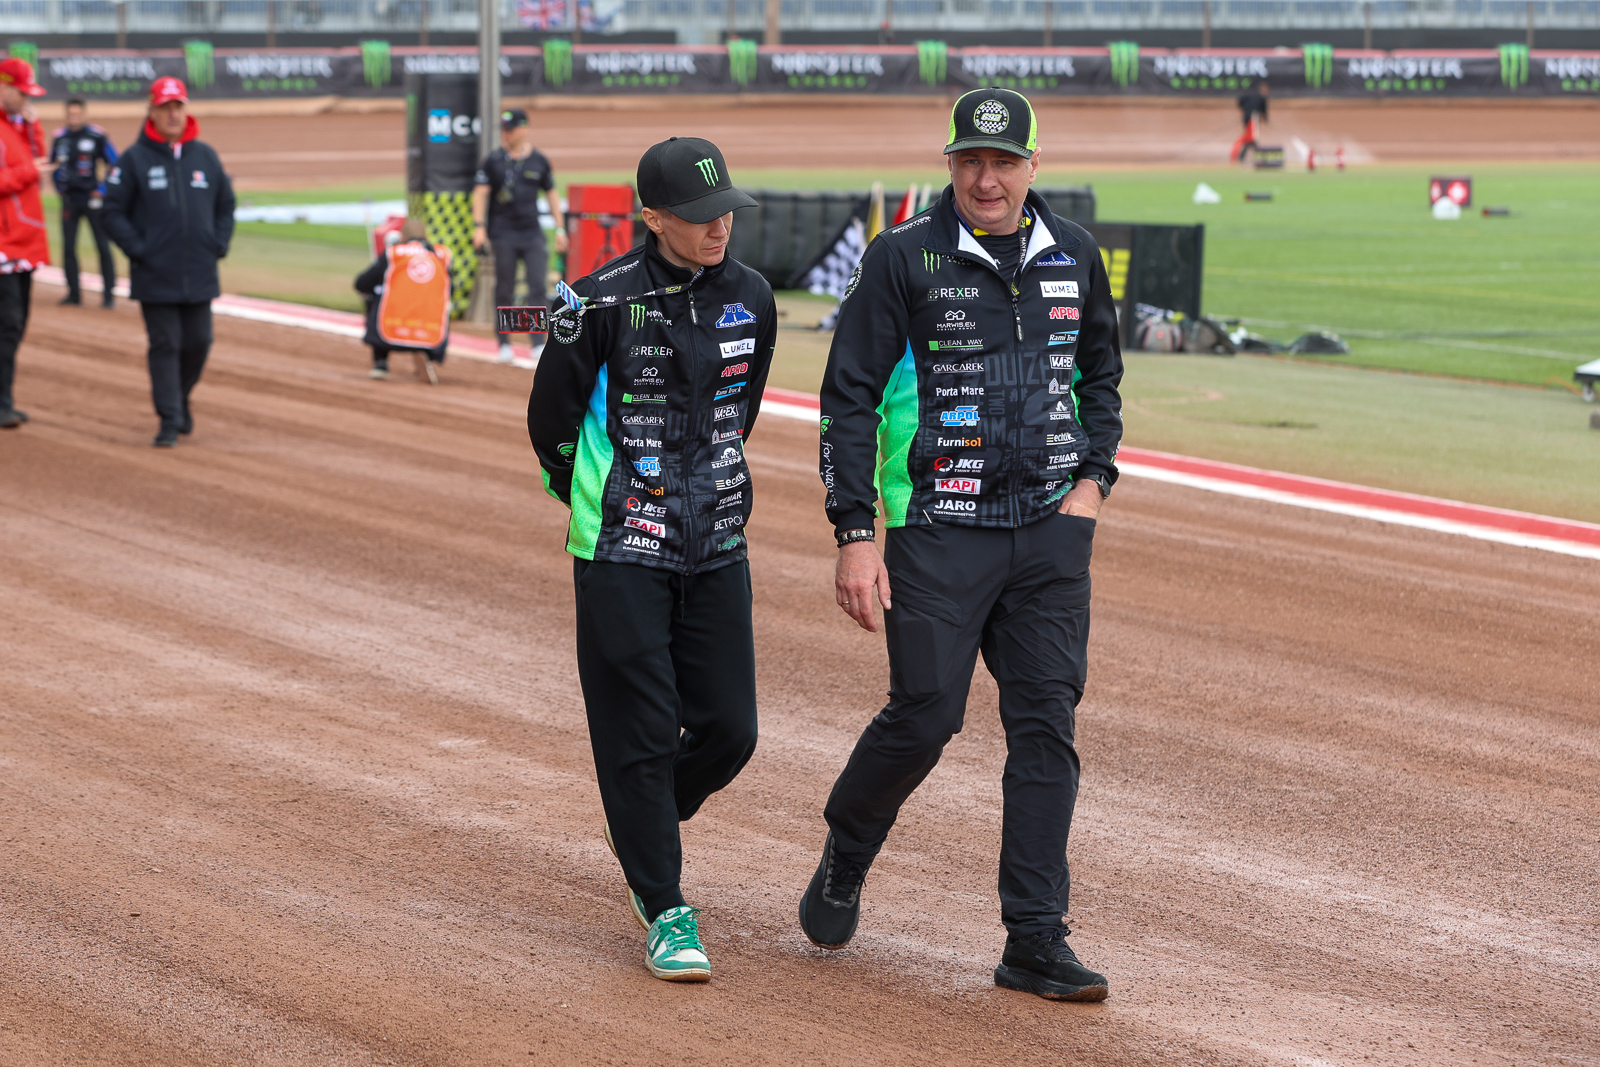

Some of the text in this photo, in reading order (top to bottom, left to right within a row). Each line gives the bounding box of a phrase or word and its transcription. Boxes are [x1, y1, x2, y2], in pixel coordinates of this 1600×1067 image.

[940, 287, 980, 298] REXER
[1043, 285, 1078, 294] LUMEL
[1048, 306, 1080, 320] APRO
[936, 321, 976, 329] MARWIS.EU
[640, 345, 674, 357] REXER
[723, 342, 753, 354] LUMEL
[720, 361, 748, 378] APRO
[932, 362, 984, 372] GARCAREK
[935, 386, 984, 397] Porta Mare
[622, 415, 665, 425] GARCAREK
[940, 410, 980, 421] ARPOL
[623, 436, 662, 448] Porta Mare
[937, 437, 981, 447] Furnisol
[821, 439, 833, 462] for
[955, 458, 985, 469] JKG
[1048, 452, 1079, 464] TEMAR
[940, 479, 976, 492] KAPI
[642, 502, 667, 514] JKG
[934, 499, 977, 511] JARO
[629, 519, 662, 535] KAPI
[623, 534, 660, 550] JARO
